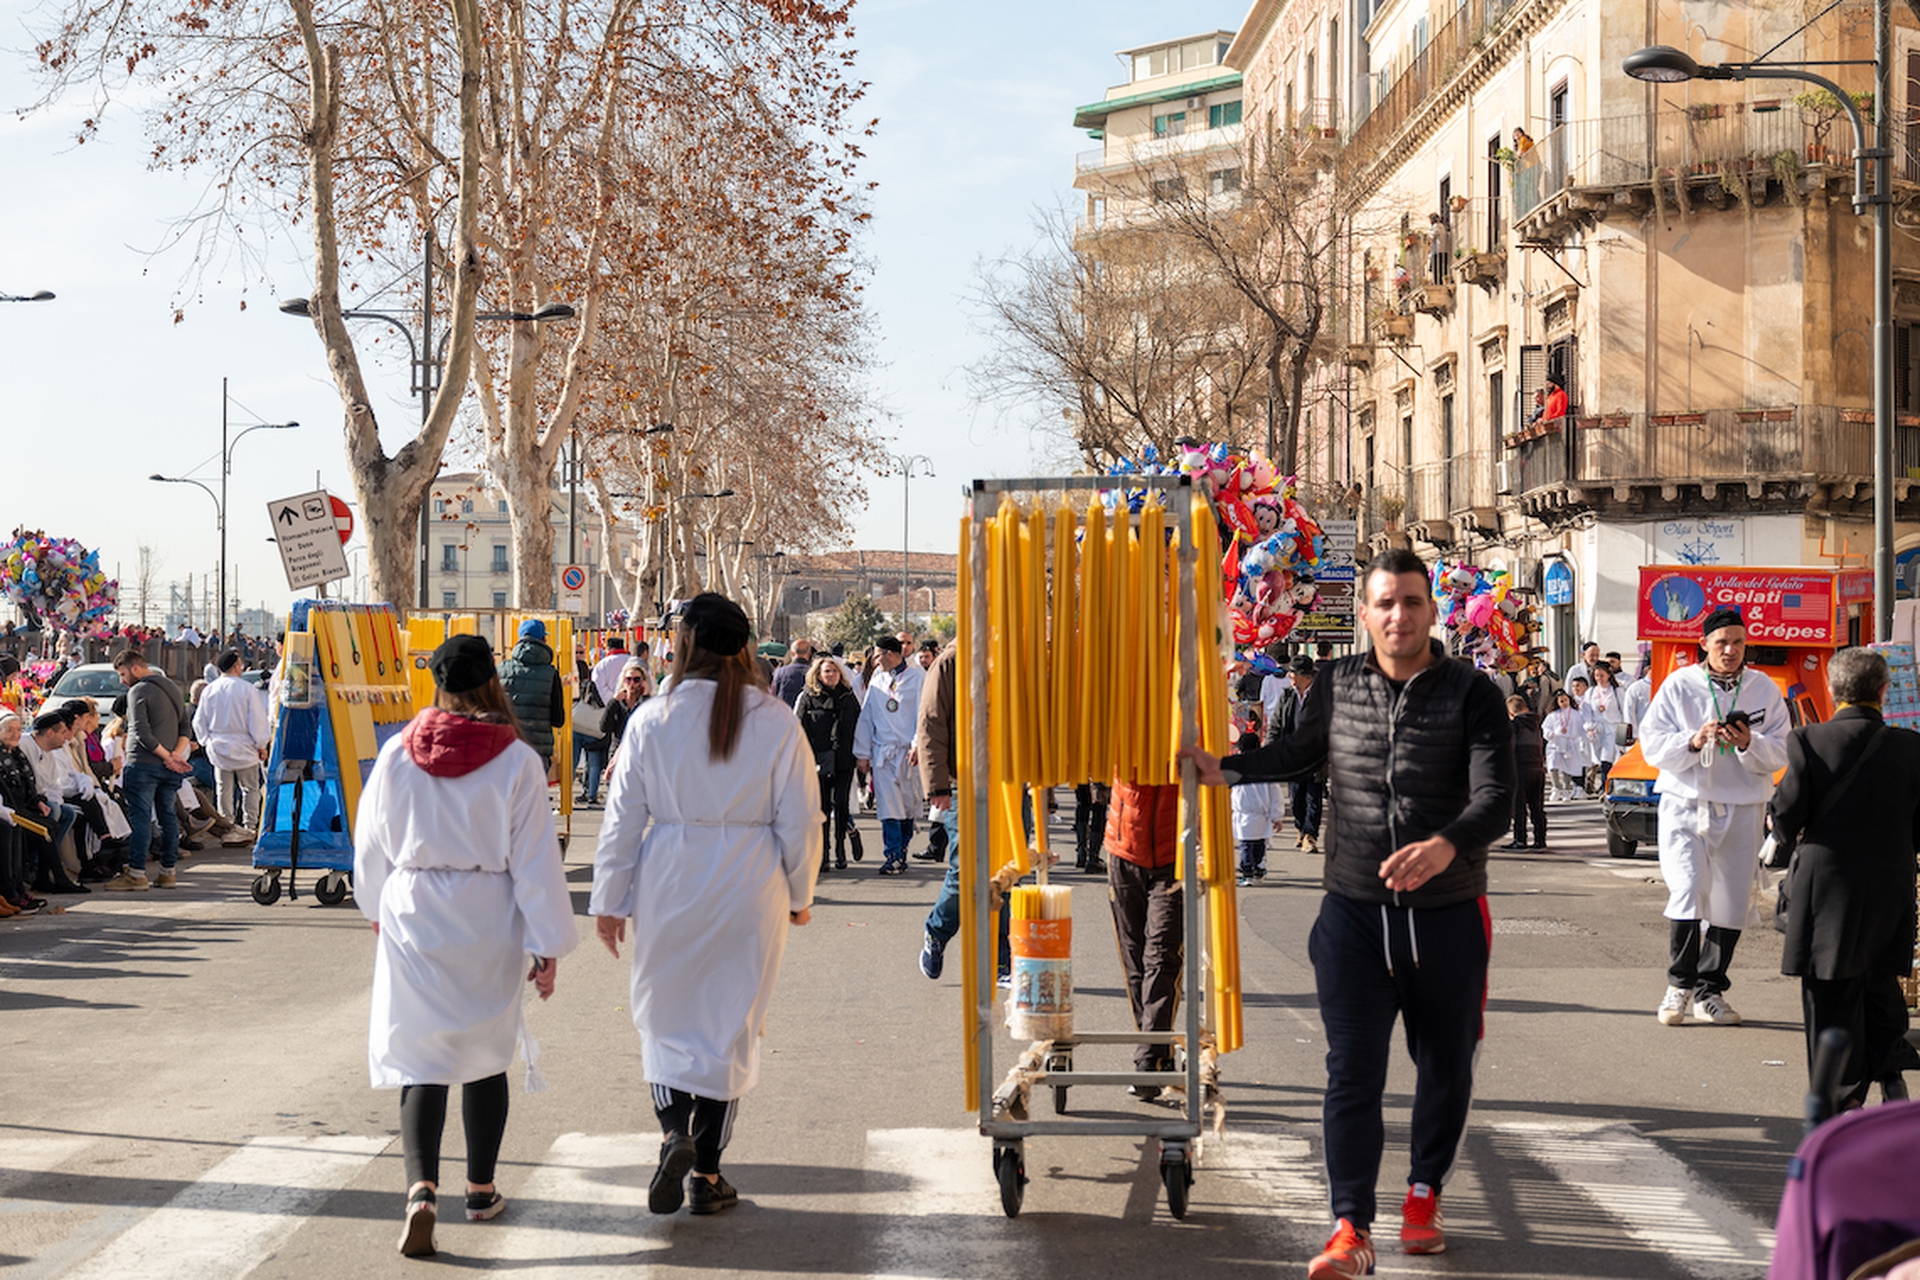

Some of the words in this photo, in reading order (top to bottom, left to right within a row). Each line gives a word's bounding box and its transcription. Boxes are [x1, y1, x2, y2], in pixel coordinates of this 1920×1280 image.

[1323, 523, 1354, 531] aeroporto
[1663, 522, 1692, 539] Olga
[1697, 521, 1735, 538] Sport
[1336, 538, 1354, 547] porto
[1321, 570, 1354, 578] SIRACUSA
[1708, 575, 1743, 589] Stella
[1744, 577, 1765, 589] del
[1765, 578, 1805, 590] Gelato
[1716, 588, 1782, 604] Gelati
[1748, 605, 1764, 620] &
[1747, 621, 1827, 640] Crépes
